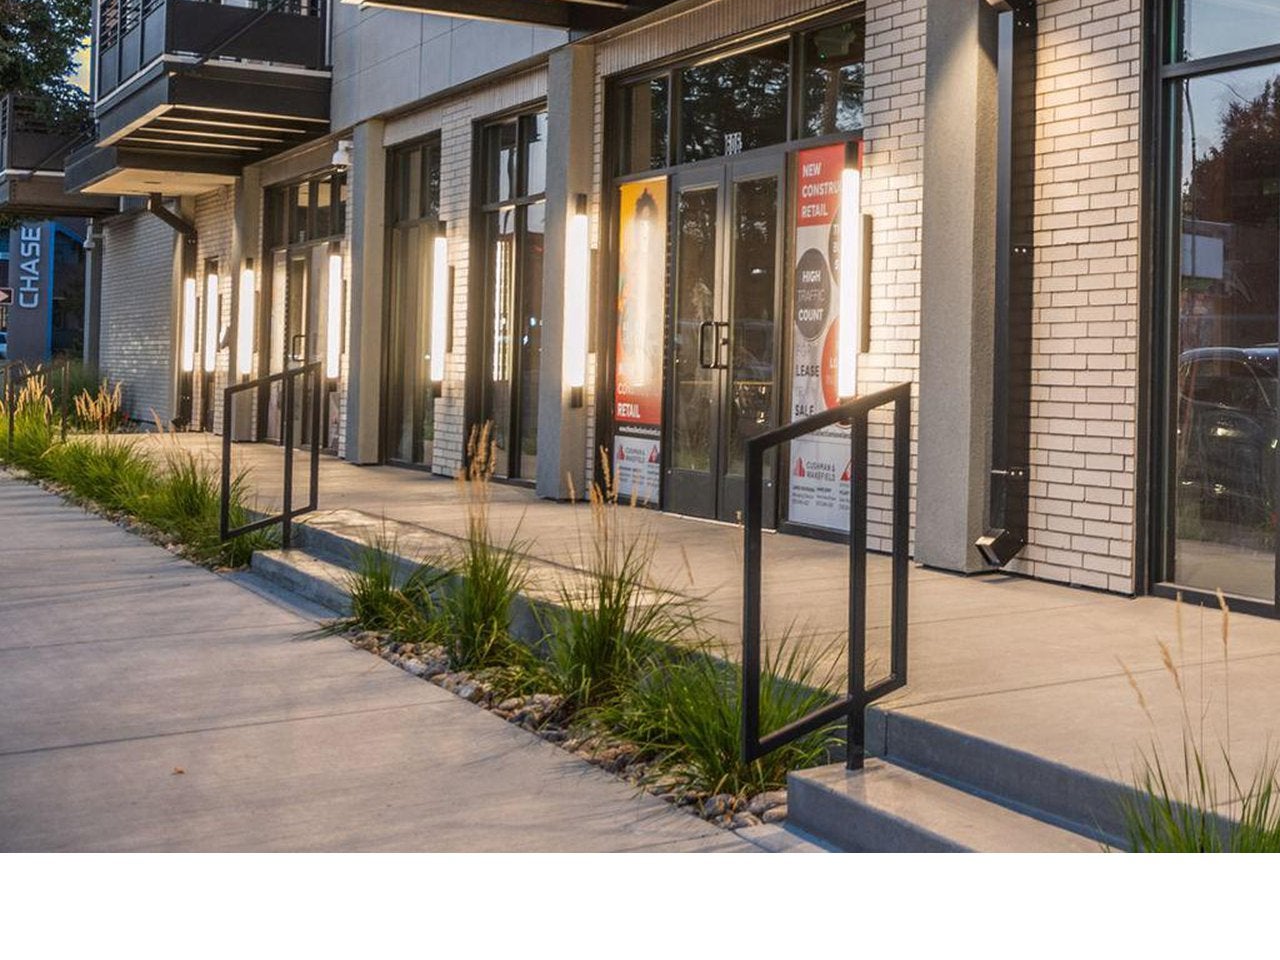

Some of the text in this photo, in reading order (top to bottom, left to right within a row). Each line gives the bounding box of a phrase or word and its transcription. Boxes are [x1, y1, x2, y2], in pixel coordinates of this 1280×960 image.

[802, 162, 822, 177] NEW
[801, 181, 842, 198] CONSTRU
[801, 203, 829, 218] RETAIL
[19, 226, 41, 308] CHASE
[802, 270, 821, 283] HIGH
[798, 308, 824, 321] COUNT
[796, 365, 820, 378] LEASE
[616, 403, 641, 418] RETAIL
